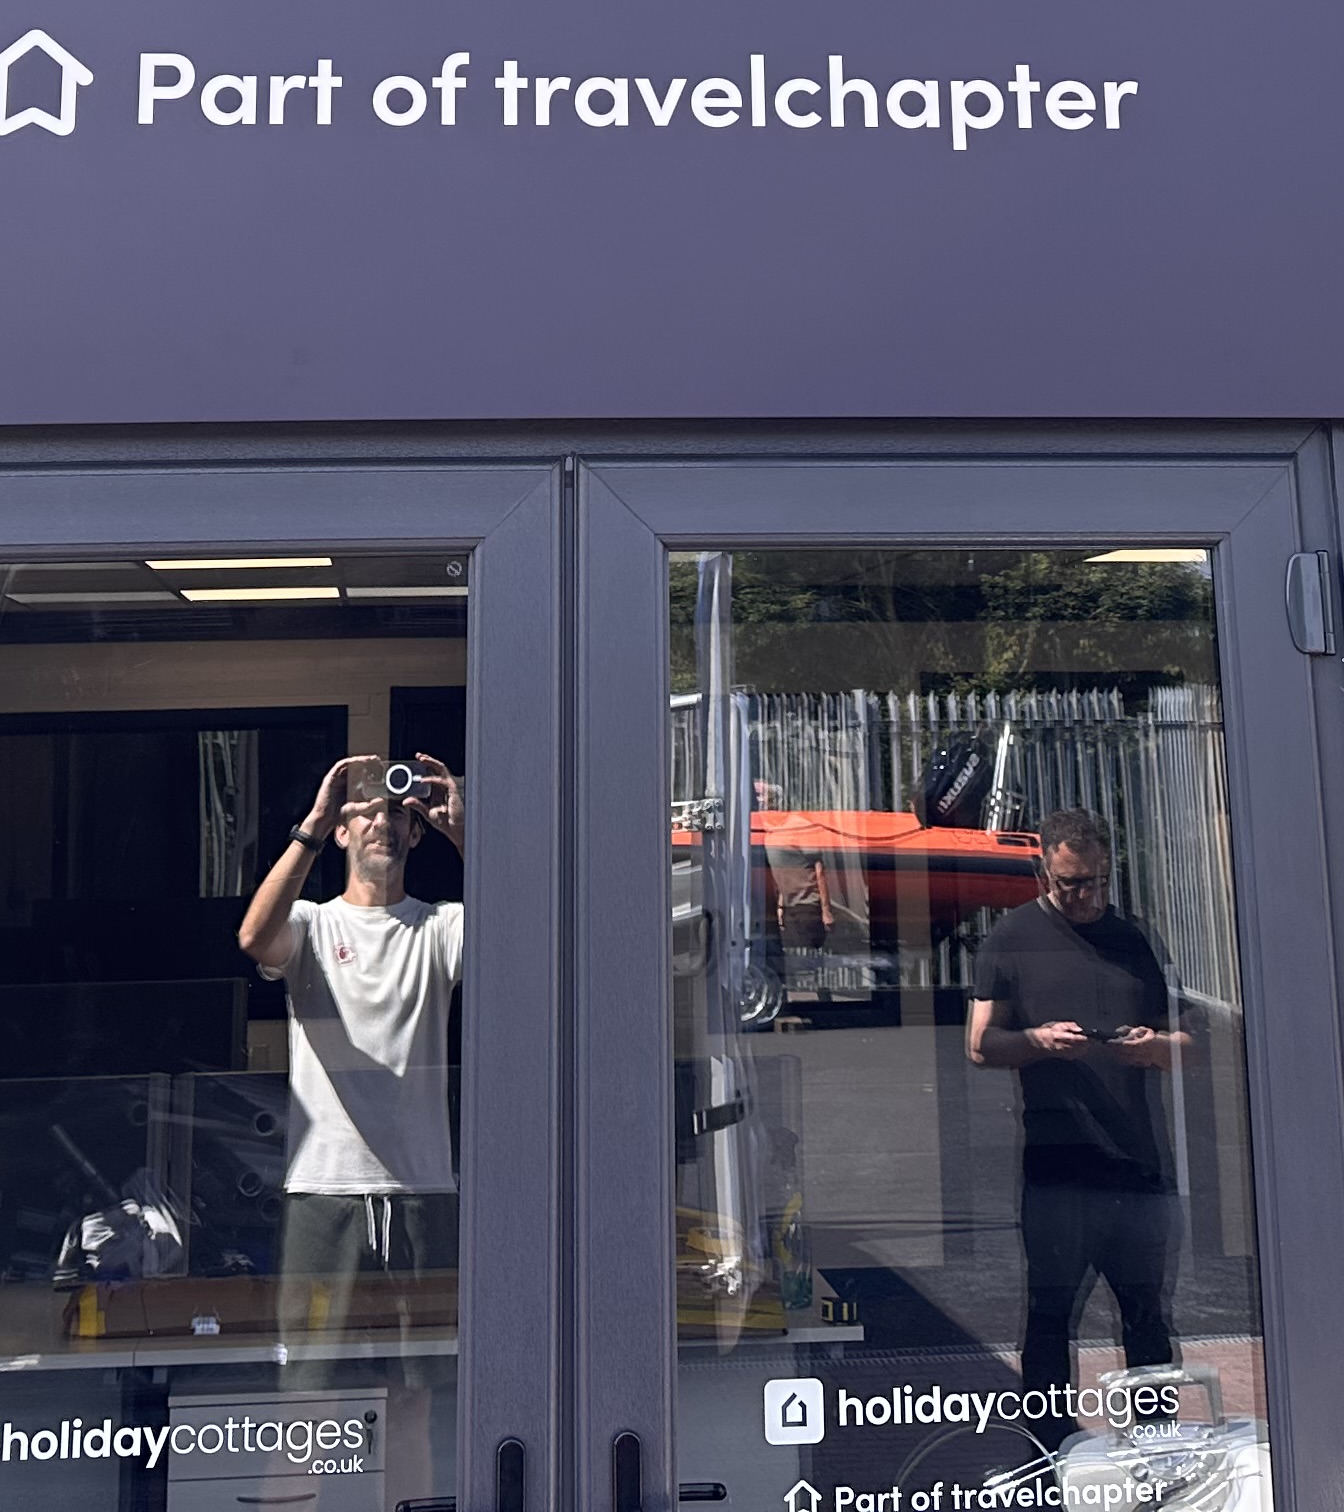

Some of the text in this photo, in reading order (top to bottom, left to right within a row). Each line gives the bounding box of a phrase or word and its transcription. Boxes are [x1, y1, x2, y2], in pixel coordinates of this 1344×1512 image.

[137, 52, 1139, 151] Part of travelchapter
[838, 1383, 1180, 1434] holidaycottages
[1129, 1419, 1182, 1439] .co.uk
[2, 1417, 364, 1469] holidaycottages
[307, 1454, 364, 1474] .co.uk
[835, 1476, 1168, 1512] Part of travelchapter
